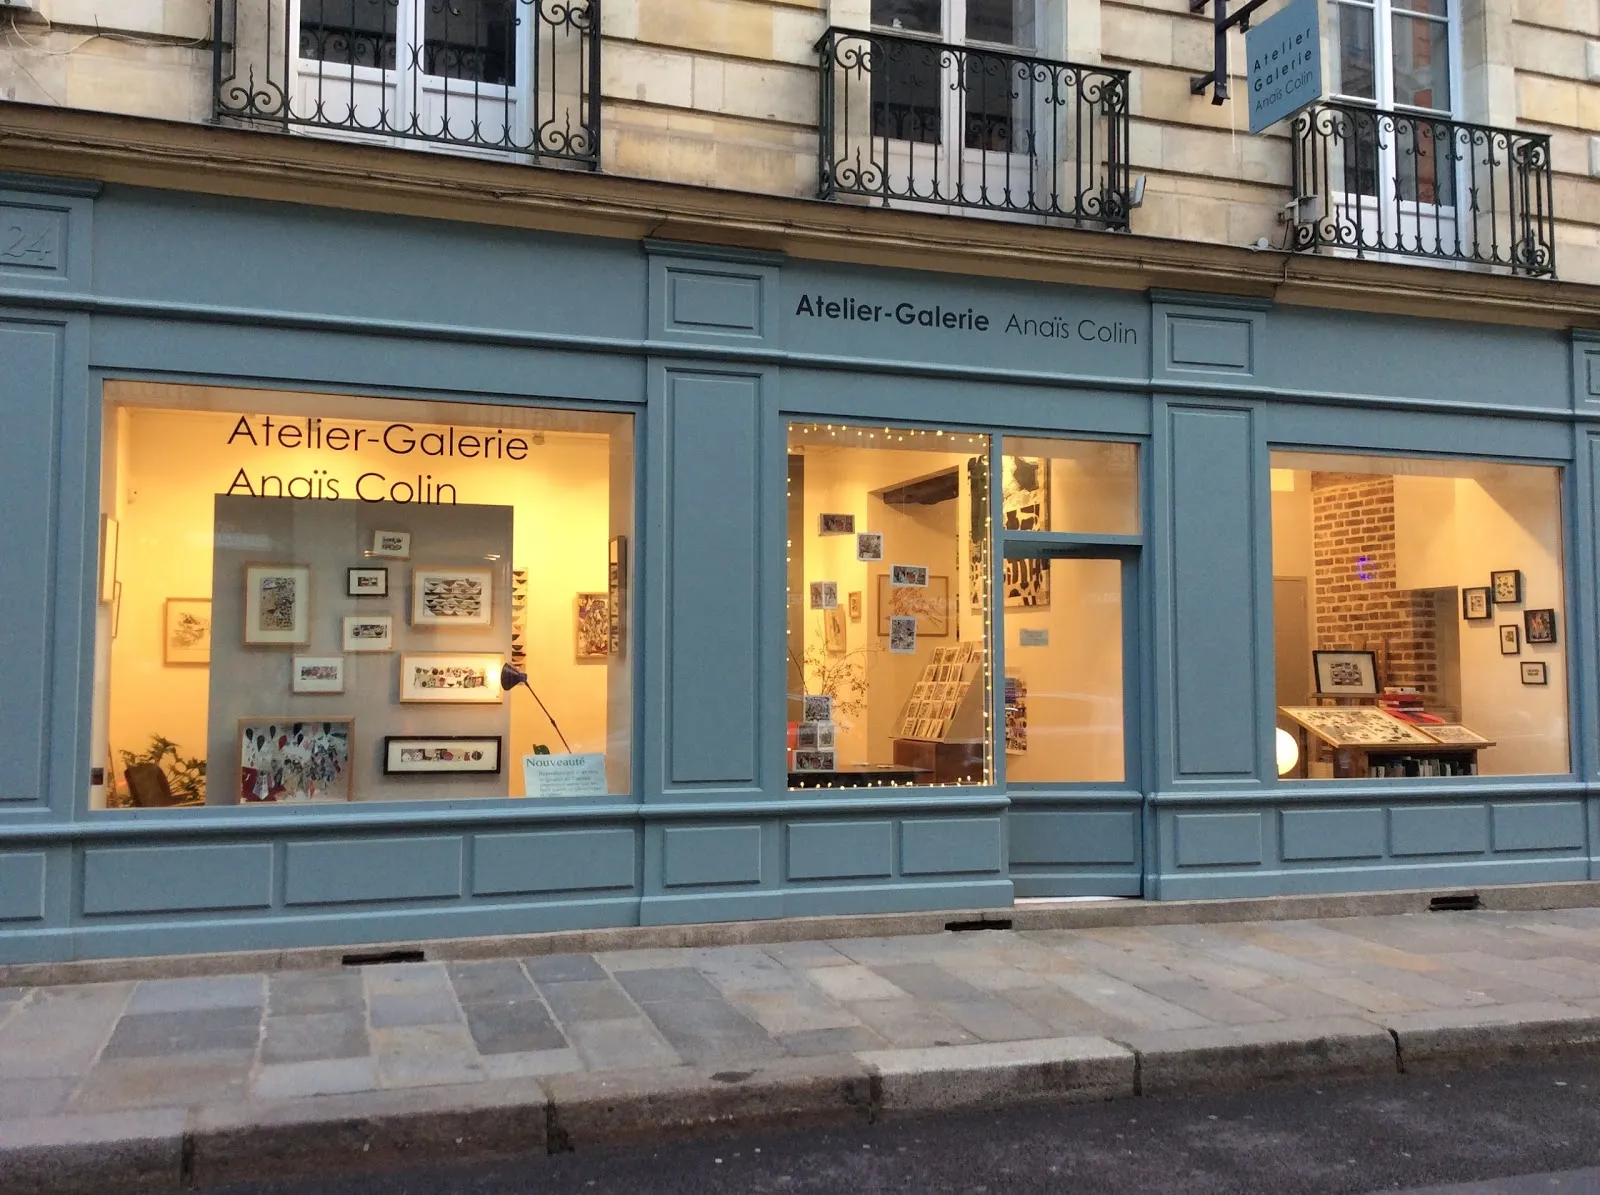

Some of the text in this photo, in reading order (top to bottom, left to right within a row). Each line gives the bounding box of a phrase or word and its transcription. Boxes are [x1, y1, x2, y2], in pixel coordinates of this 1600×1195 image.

[1253, 28, 1311, 73] Atelier
[1254, 50, 1312, 92] Galerie
[1255, 70, 1313, 112] Anaïs Colin
[795, 294, 1138, 345] Atelier-Galerie Anaïs Colin
[226, 415, 529, 461] Atelier-Galerie
[226, 467, 457, 507] Anaïs Colin
[526, 756, 585, 768] Nouveauté
